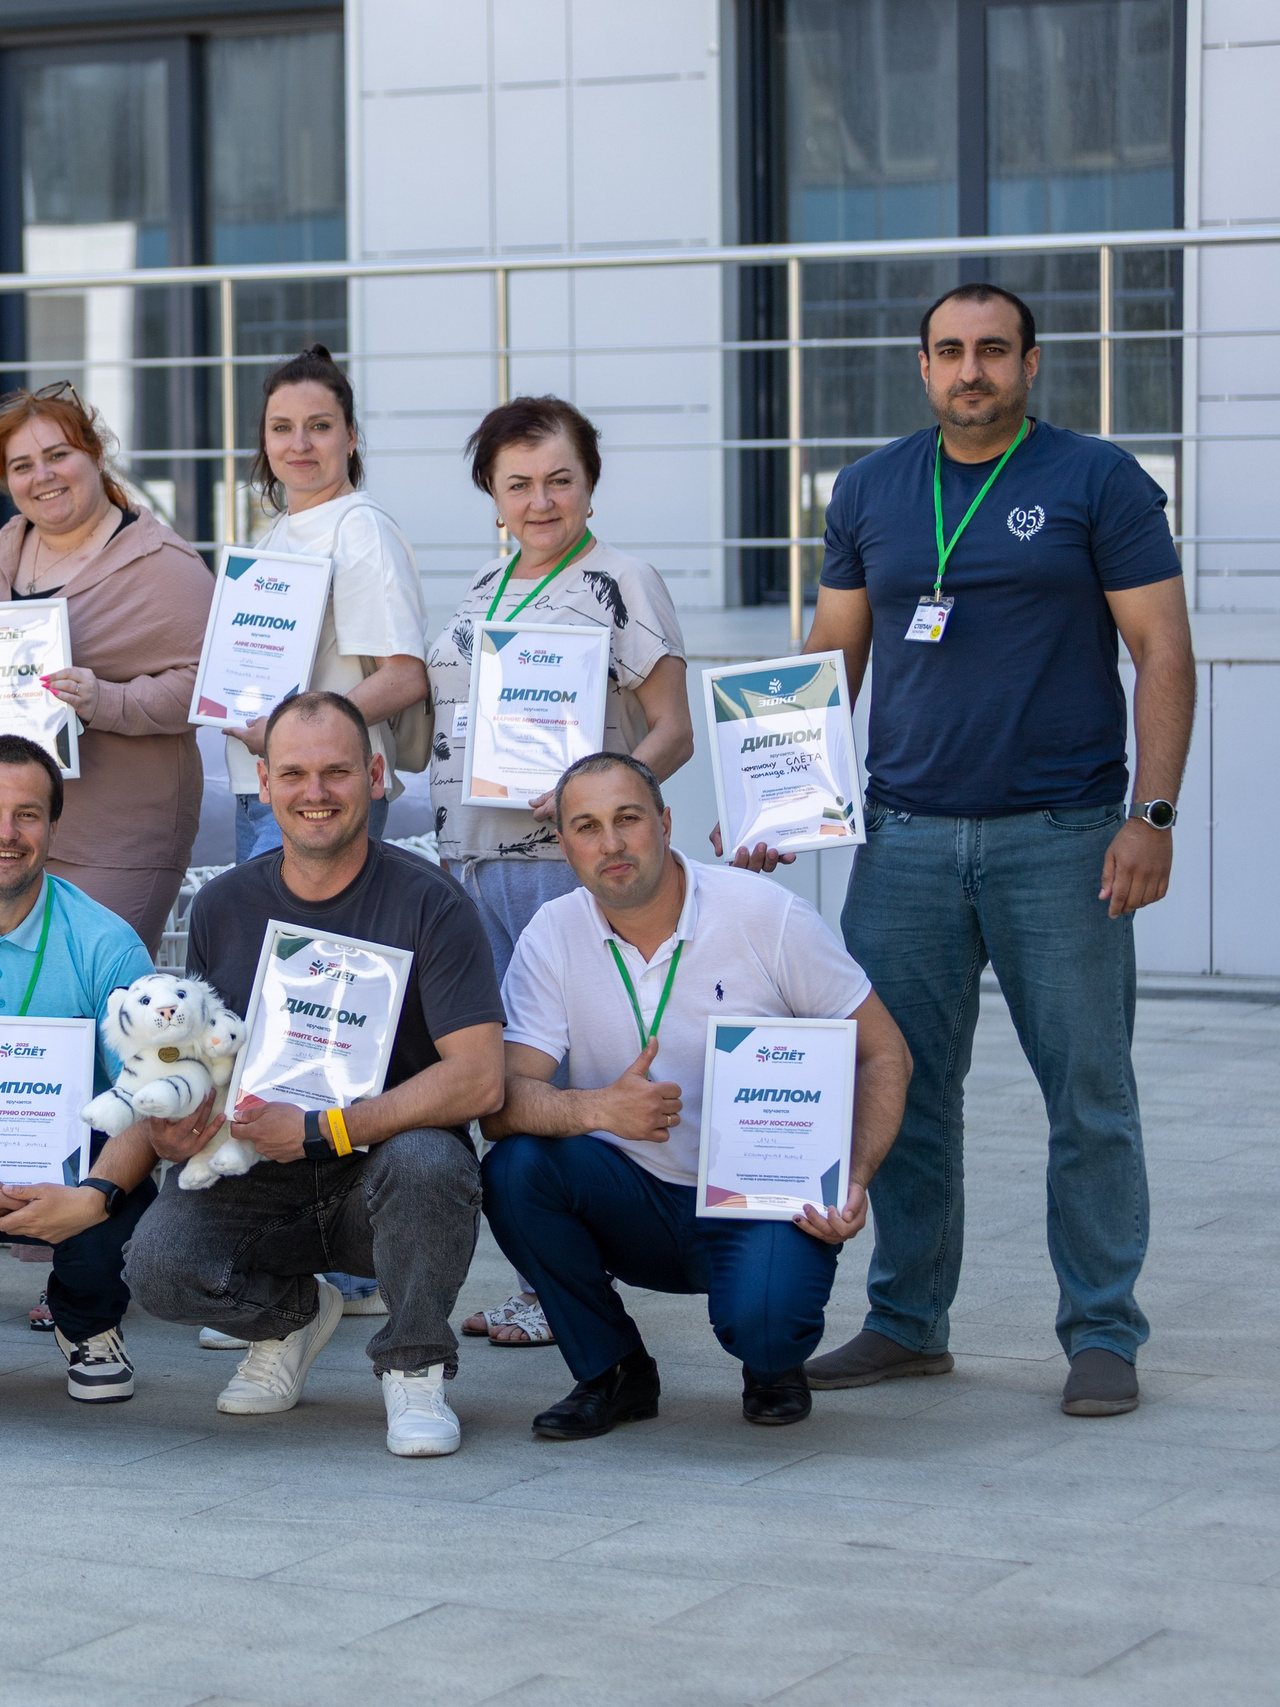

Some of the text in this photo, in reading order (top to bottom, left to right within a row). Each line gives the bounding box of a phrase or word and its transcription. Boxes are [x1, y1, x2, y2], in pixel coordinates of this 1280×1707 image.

[1016, 510, 1037, 529] 95
[265, 581, 290, 592] СЛЁТ
[232, 612, 296, 632] ДИПЛОМ
[532, 654, 564, 664] СЛЁТ
[498, 688, 577, 703] ДИПЛОМ
[740, 728, 822, 754] ДИПЛОМ
[324, 968, 358, 982] СЛЁТ
[280, 998, 367, 1028] ДИПЛОМ
[14, 1046, 47, 1056] СЛЁТ
[772, 1050, 805, 1061] СЛЁТ
[734, 1088, 821, 1104] ДИПЛОМ
